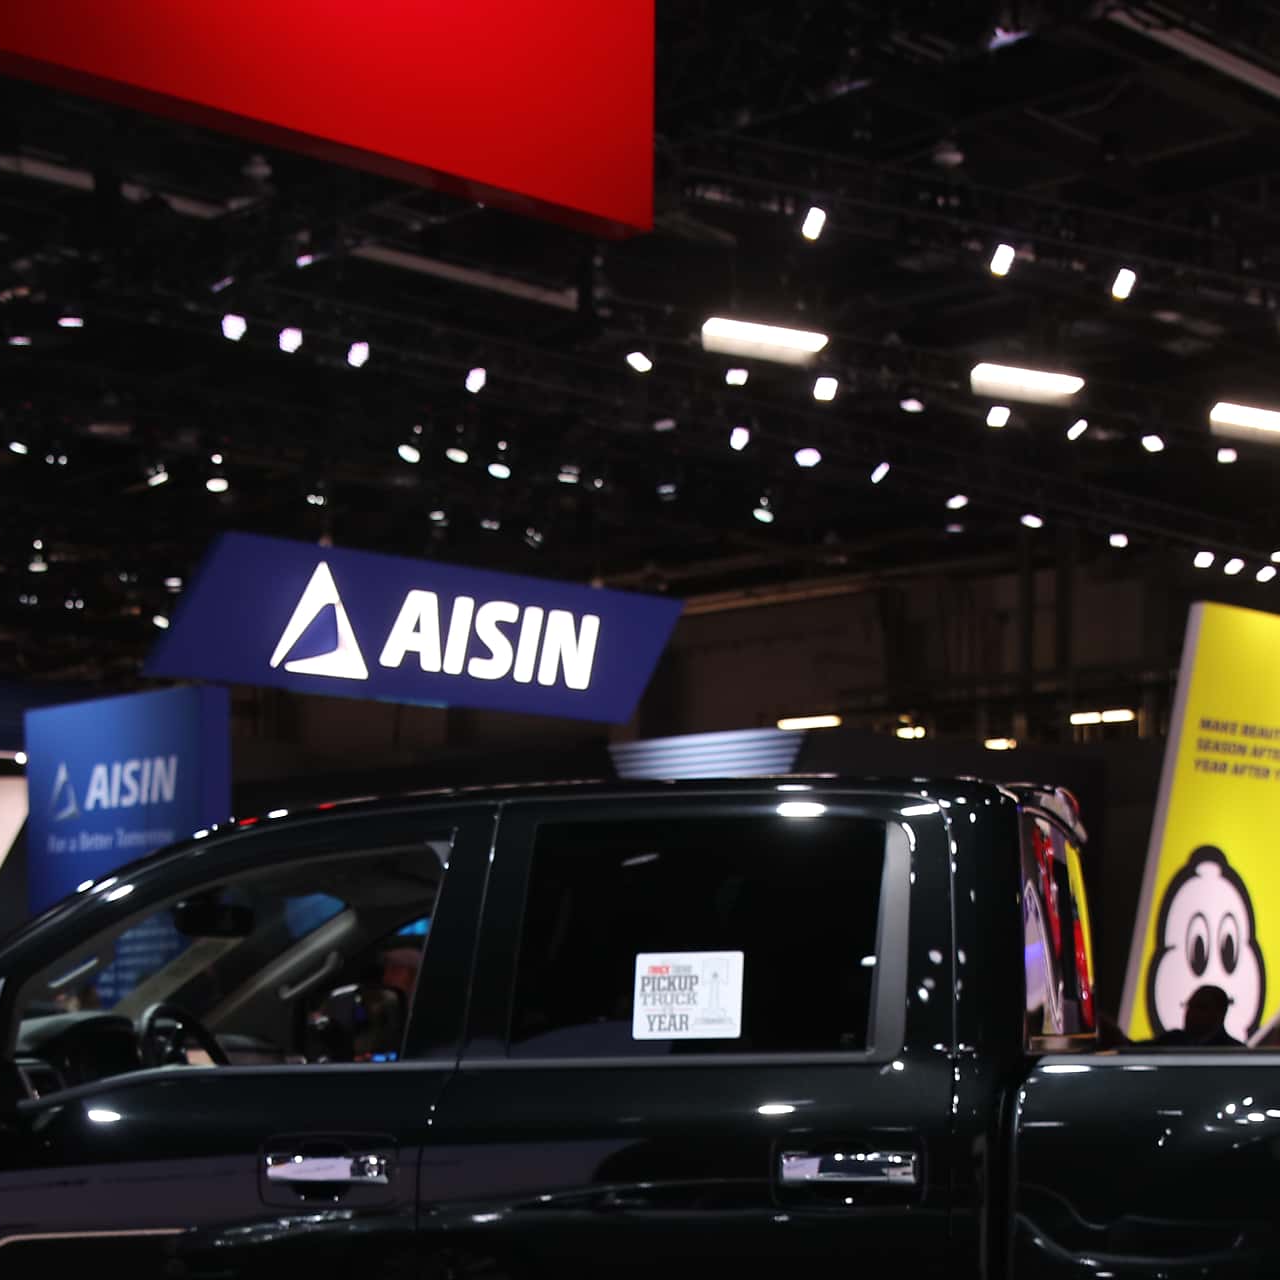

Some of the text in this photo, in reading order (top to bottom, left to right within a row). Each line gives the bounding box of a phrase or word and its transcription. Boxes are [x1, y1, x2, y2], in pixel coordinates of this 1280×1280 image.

[379, 589, 600, 690] AISIN
[1200, 717, 1238, 736] MAKE
[1197, 738, 1248, 756] SEASON
[1194, 759, 1228, 774] YEAR
[1231, 763, 1270, 780] AFTER
[84, 754, 178, 812] AISIN
[640, 975, 699, 992] PICKUP
[640, 991, 698, 1006] TRUCK
[647, 1014, 689, 1032] YEAR
